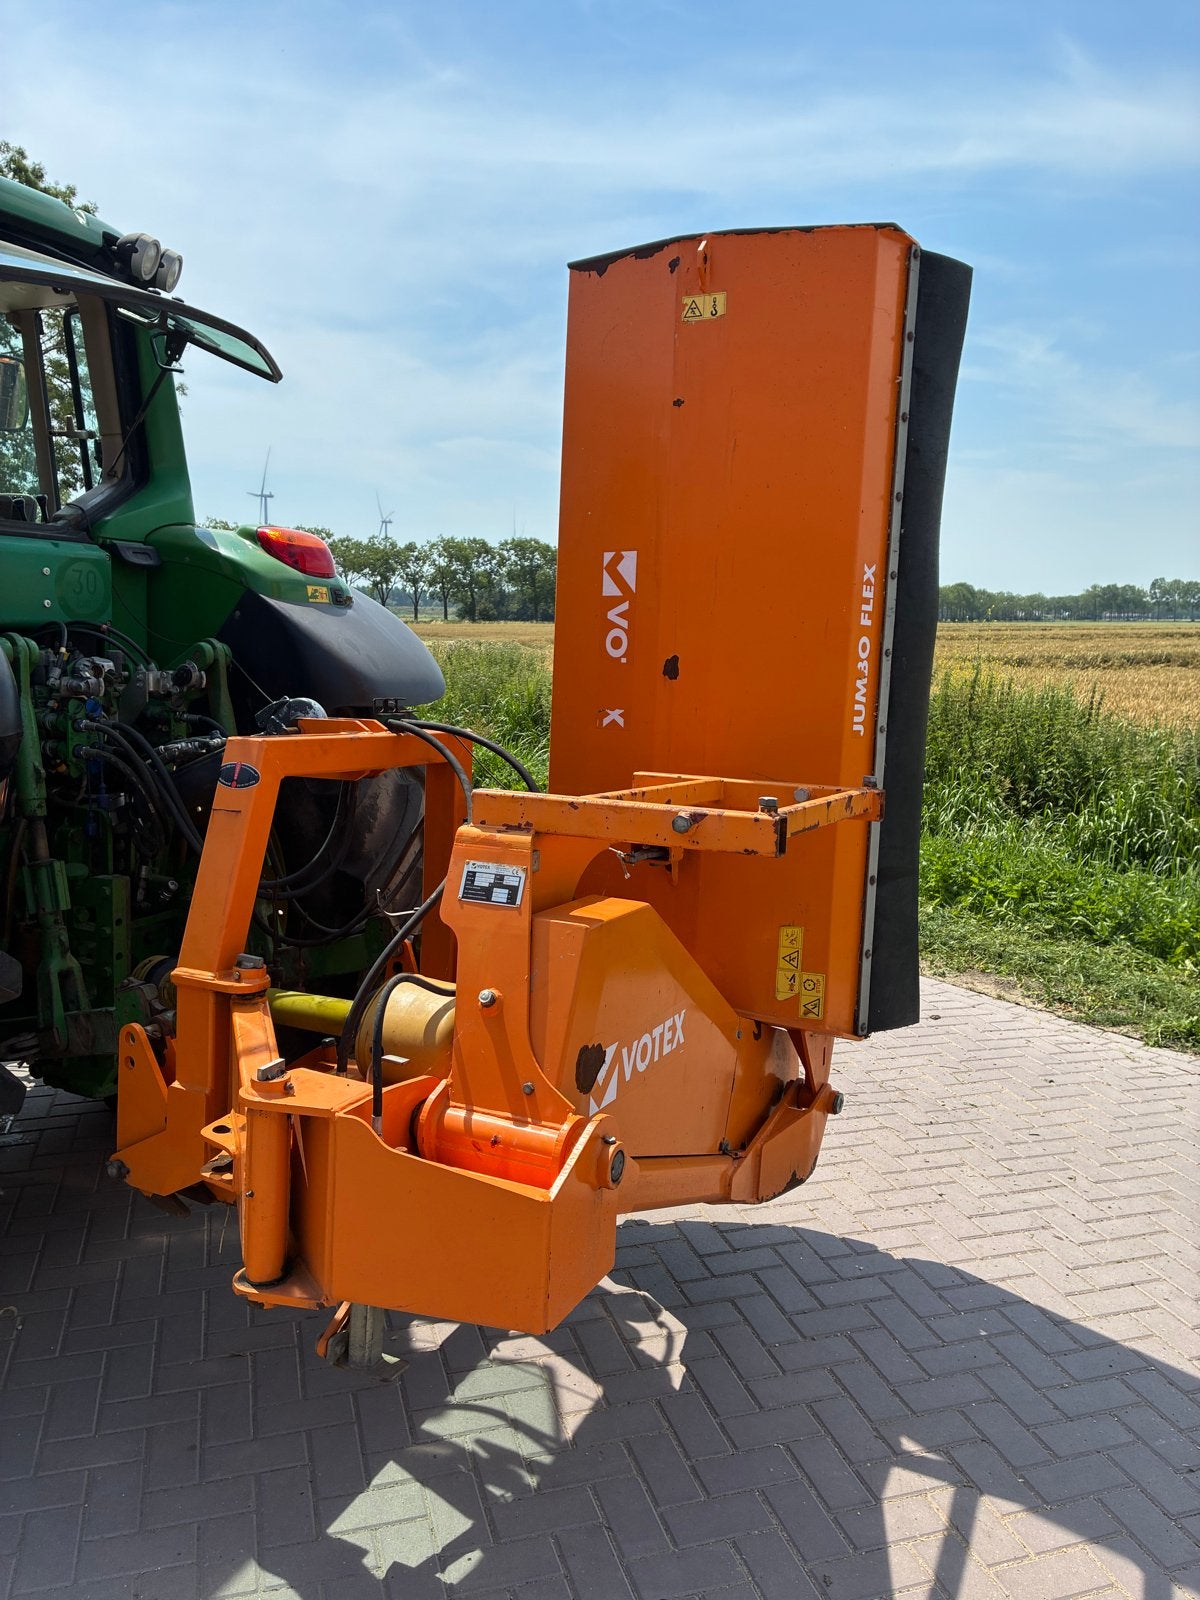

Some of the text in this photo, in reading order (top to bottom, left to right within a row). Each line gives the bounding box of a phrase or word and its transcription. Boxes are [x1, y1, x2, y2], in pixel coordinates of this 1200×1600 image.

[72, 569, 97, 595] 30
[860, 563, 877, 627] FLEX
[621, 1008, 687, 1082] VOTEX
